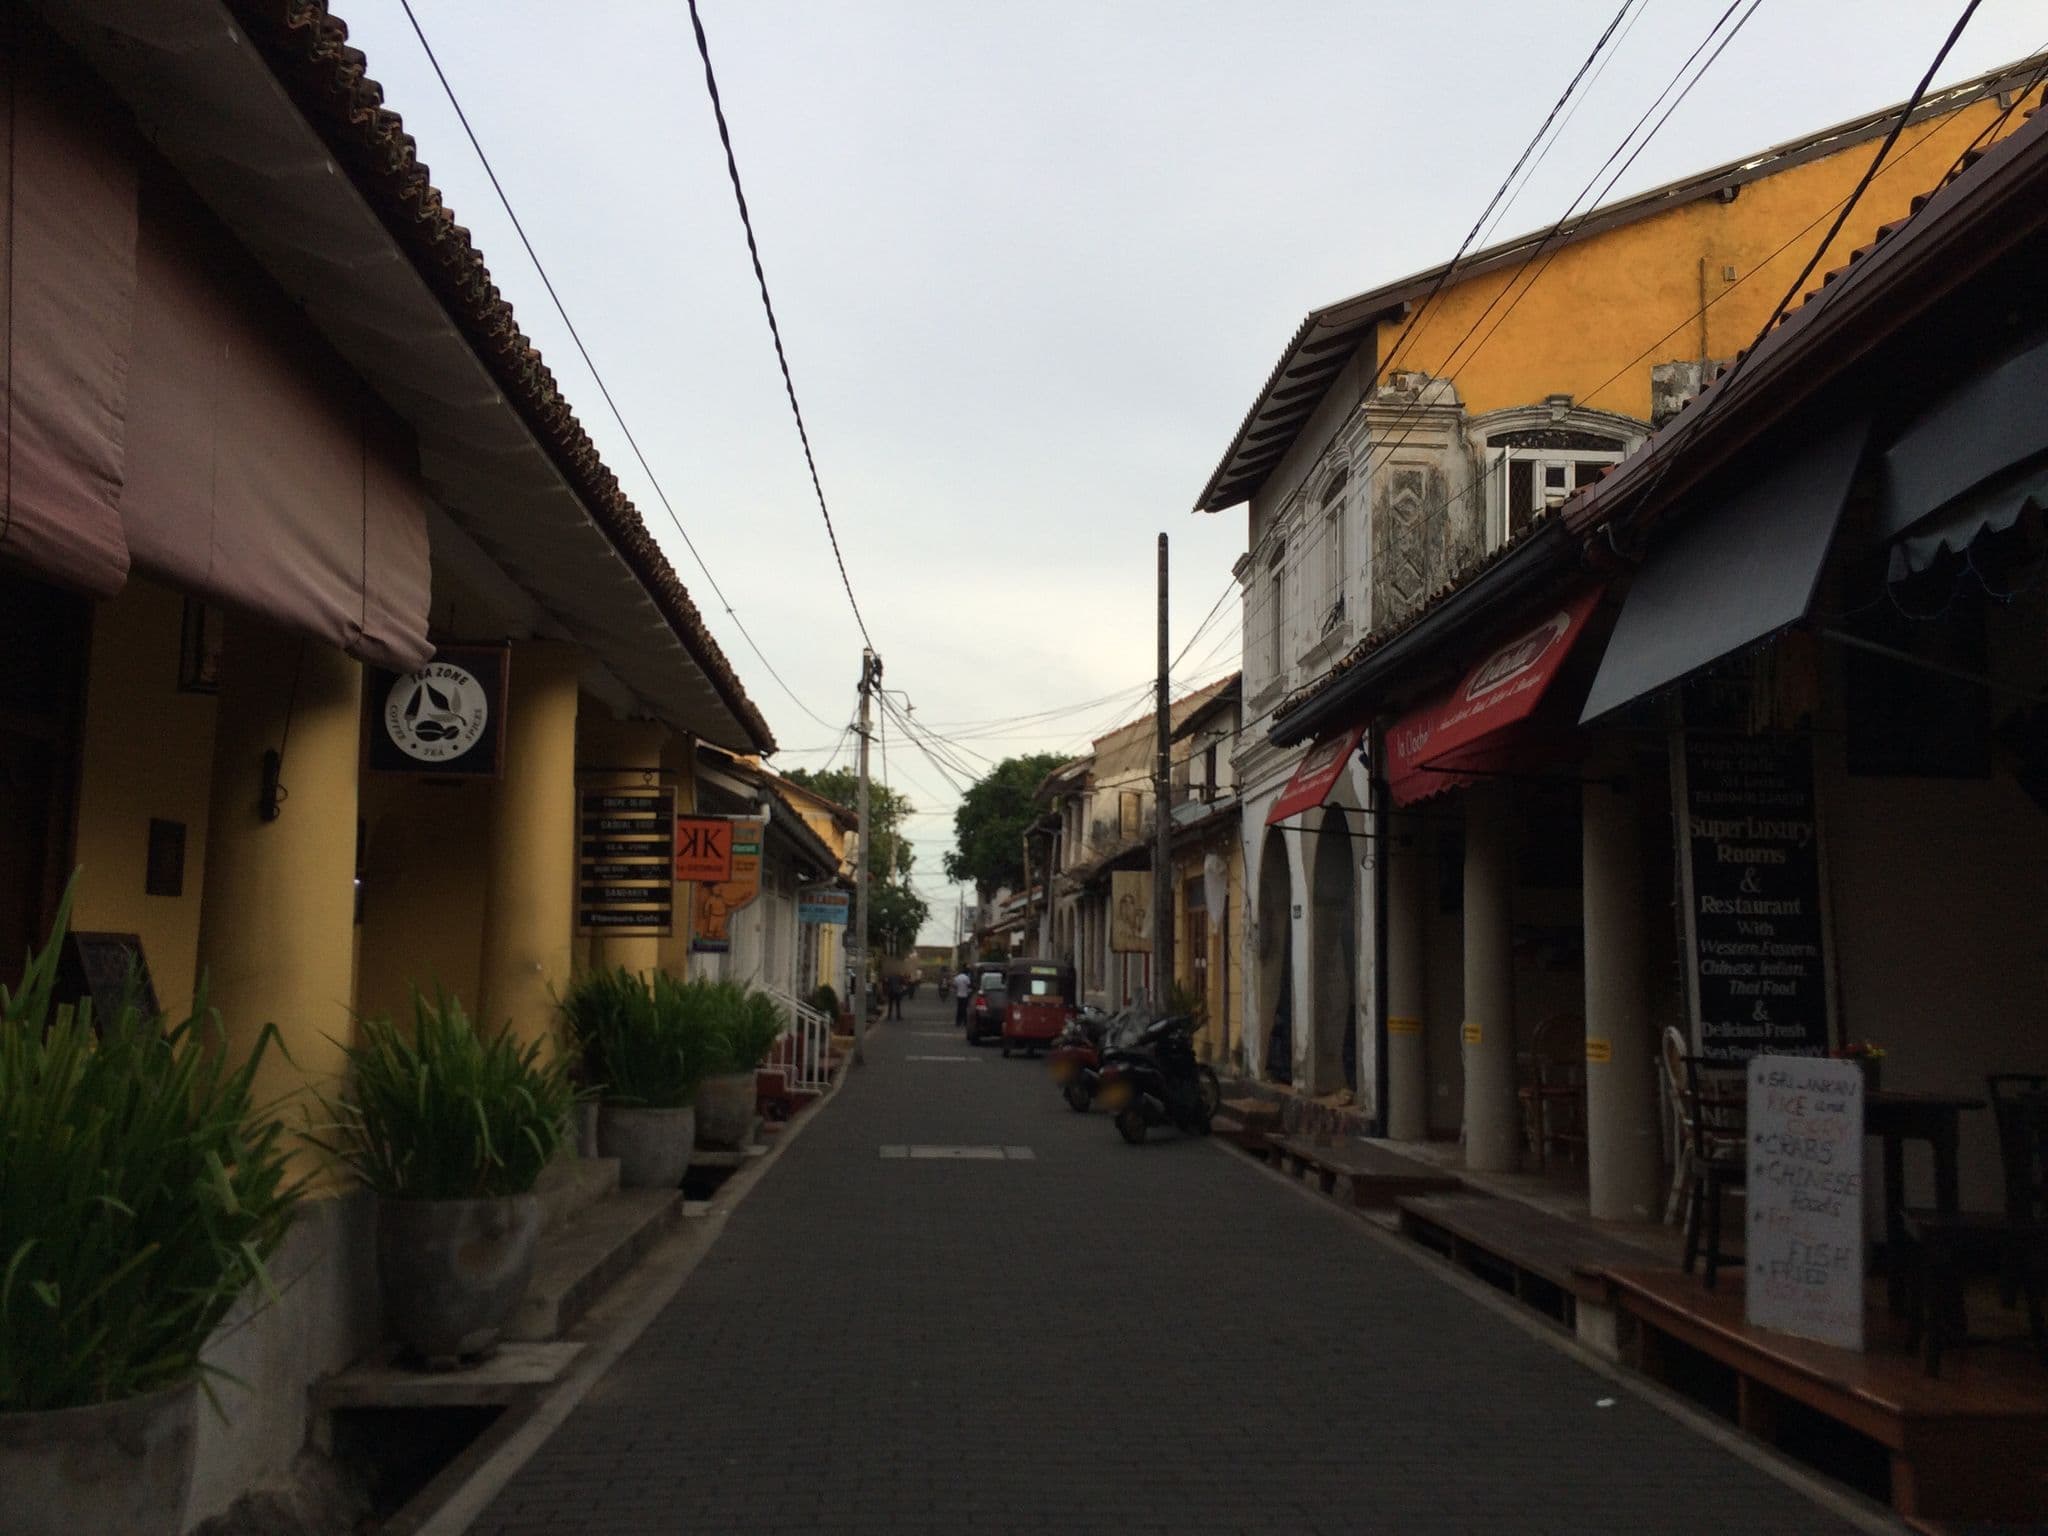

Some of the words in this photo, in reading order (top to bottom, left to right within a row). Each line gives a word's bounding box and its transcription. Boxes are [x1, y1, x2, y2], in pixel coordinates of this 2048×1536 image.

[436, 667, 469, 686] ZONE
[1717, 844, 1786, 864] Rooms
[1740, 867, 1761, 893] &
[1700, 896, 1801, 914] Restaurant
[1737, 919, 1775, 937] With
[1762, 979, 1796, 996] Food
[1751, 999, 1769, 1022] &
[1765, 1133, 1836, 1166] CRABS
